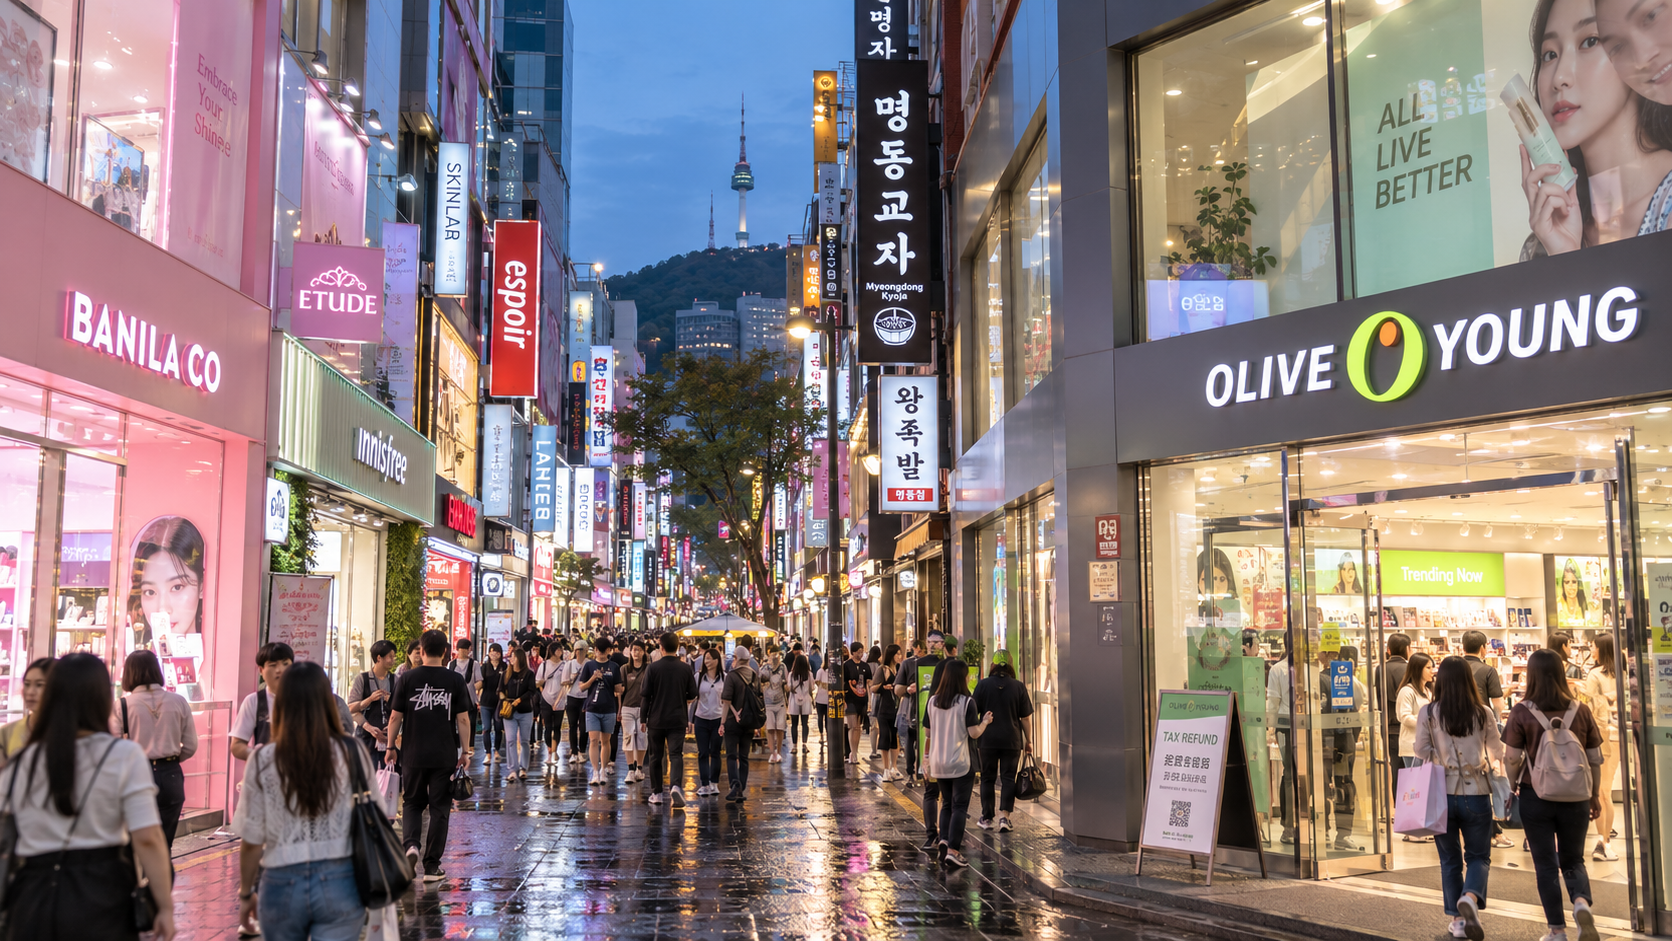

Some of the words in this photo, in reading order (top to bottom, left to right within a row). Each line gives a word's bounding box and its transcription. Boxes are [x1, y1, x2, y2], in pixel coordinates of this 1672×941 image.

[867, 0, 897, 59] 명자
[197, 53, 238, 106] Embrace
[198, 82, 223, 123] Your
[1377, 92, 1425, 134] ALL
[1376, 126, 1432, 172] LIVE
[873, 89, 916, 276] 명동교자
[1375, 154, 1473, 210] BETTER
[299, 289, 378, 315] ETUDE
[497, 260, 532, 350] espoir
[865, 282, 924, 294] Myeongdong
[881, 292, 908, 302] Kyoja
[69, 290, 181, 381] BANILA
[185, 343, 222, 393] CO
[1205, 344, 1335, 408] OLIVE
[1433, 286, 1640, 371] YOUNG
[357, 427, 408, 485] innisfree
[894, 385, 925, 481] 왕족발
[1401, 566, 1454, 586] Trending
[1456, 567, 1484, 584] Now
[1163, 731, 1181, 743] TAX
[1181, 732, 1219, 746] REFUND
